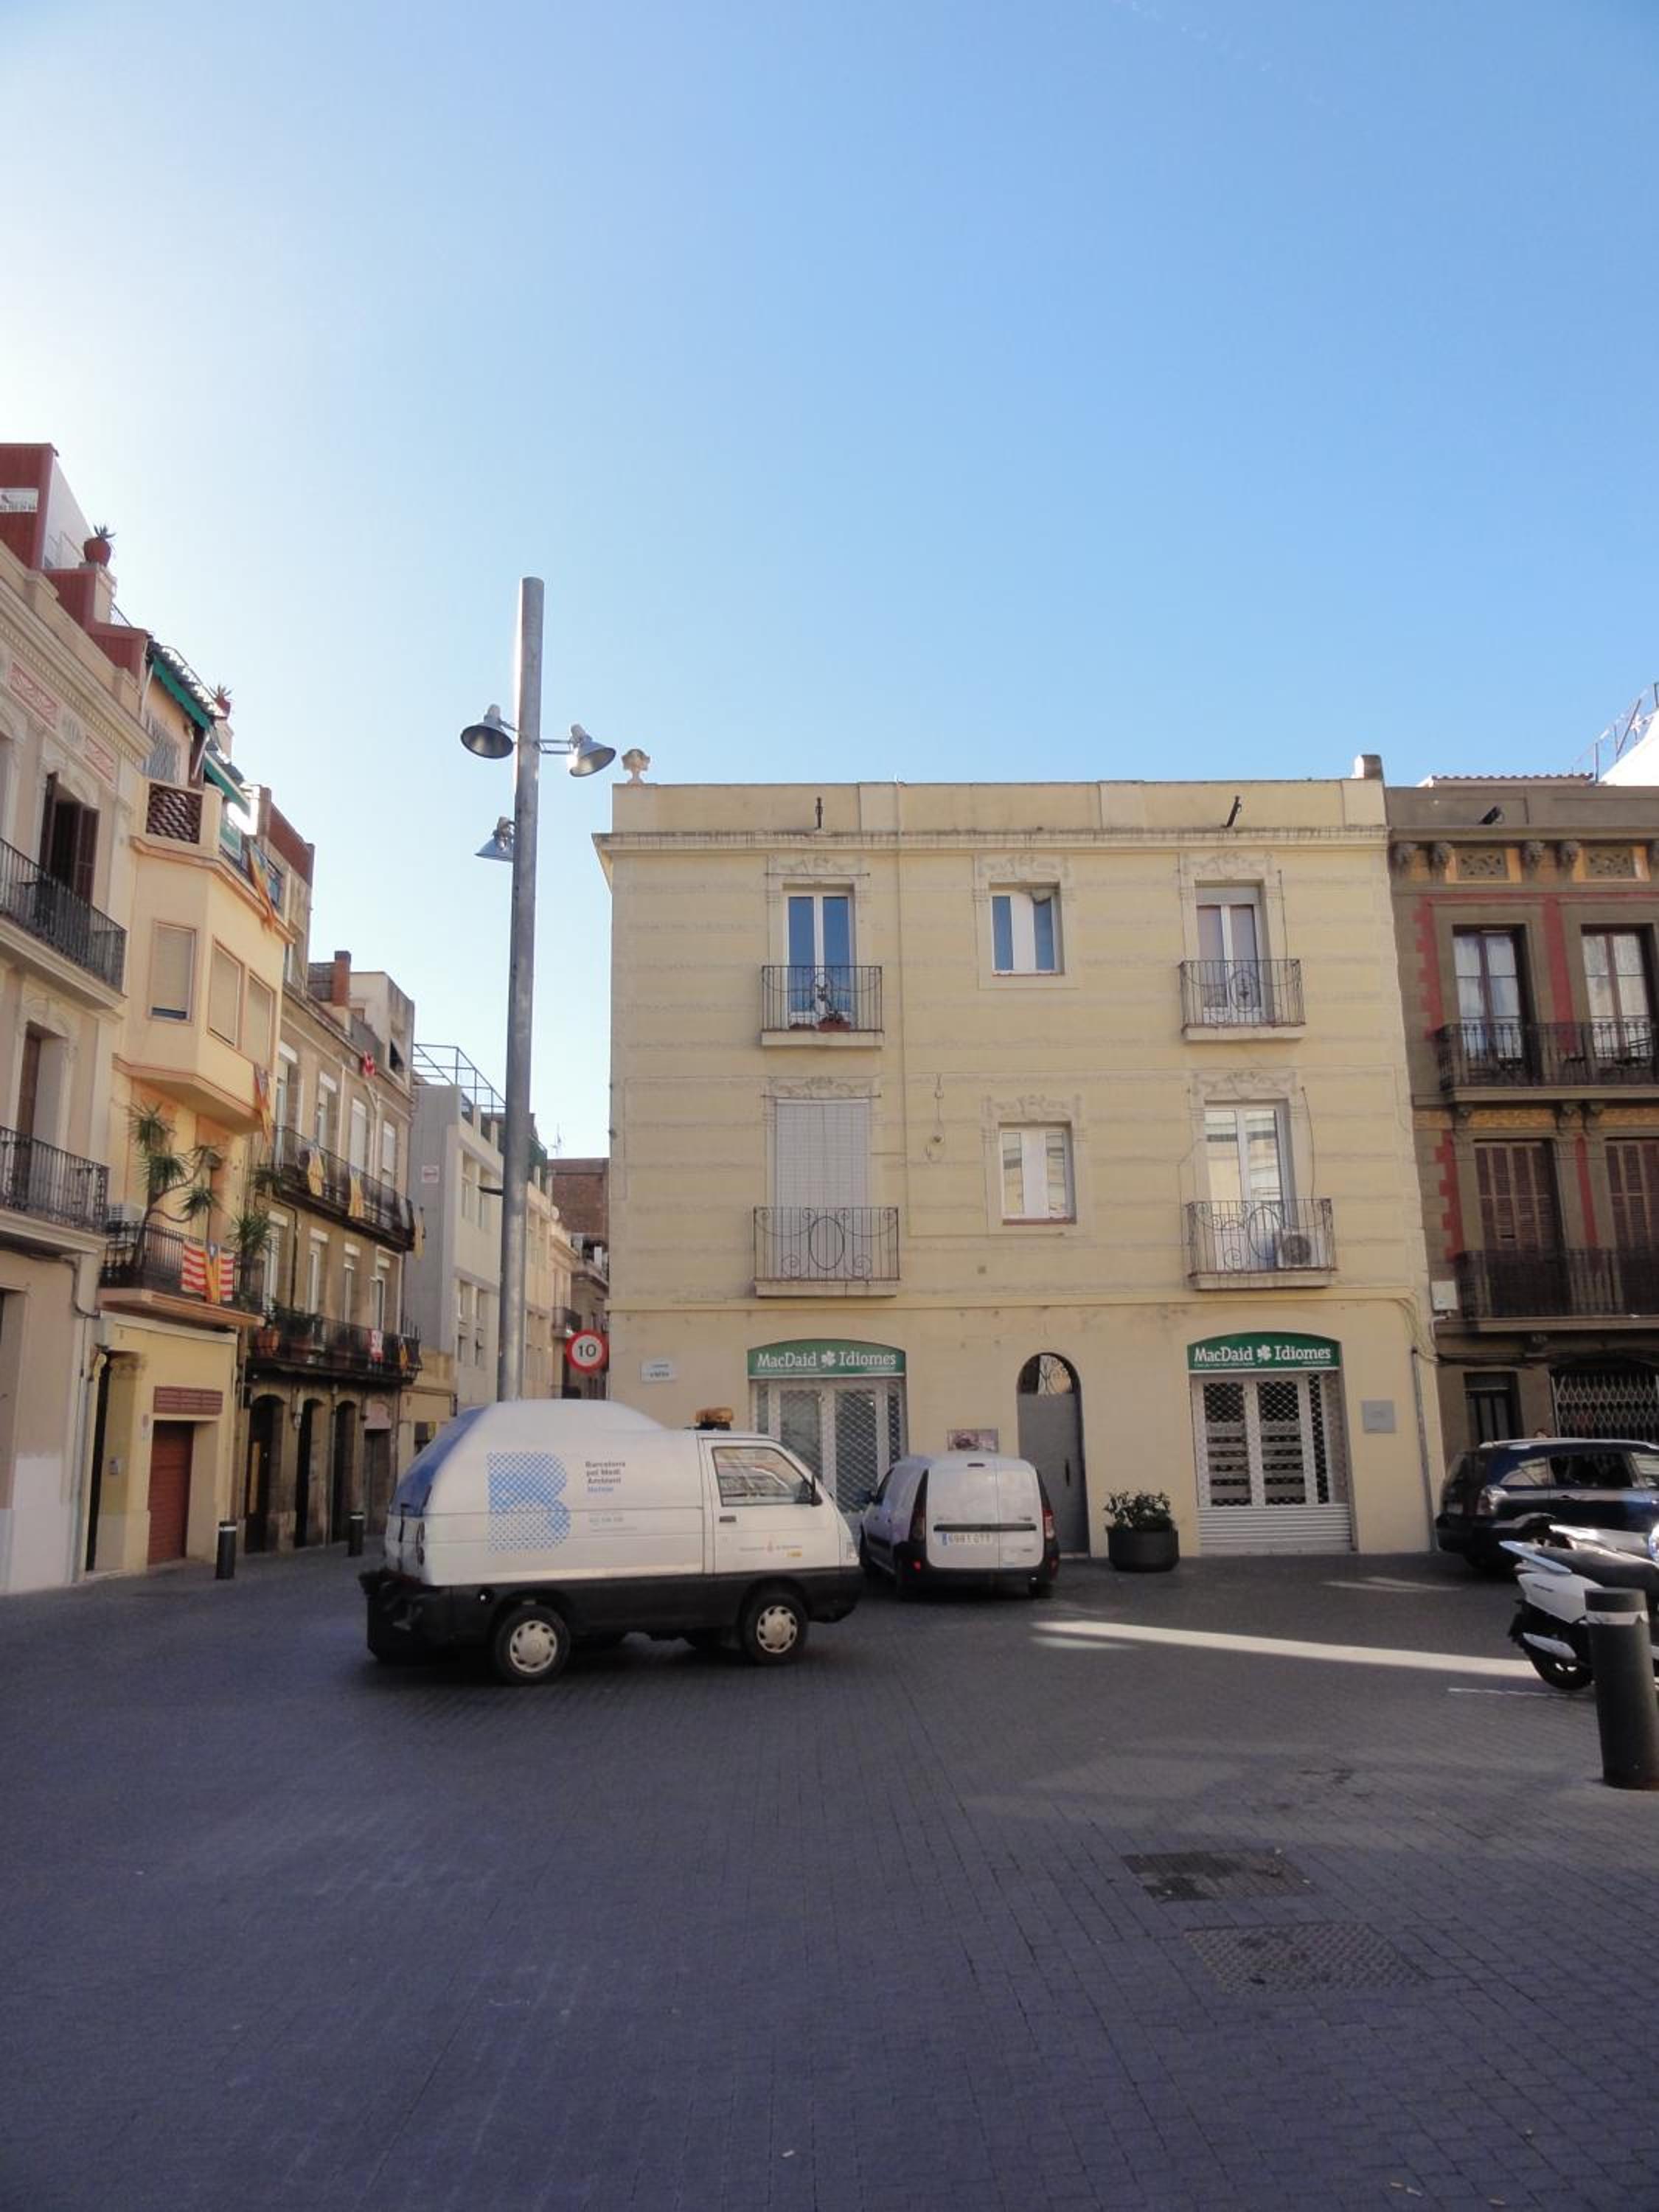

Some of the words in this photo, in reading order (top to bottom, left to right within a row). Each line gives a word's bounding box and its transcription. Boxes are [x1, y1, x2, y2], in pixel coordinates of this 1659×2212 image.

[578, 1343, 597, 1357] 10
[757, 1351, 816, 1368] MacDaid
[838, 1350, 897, 1366] Idiomes
[1194, 1346, 1253, 1363] MacDaid
[1273, 1345, 1332, 1360] Idiomes
